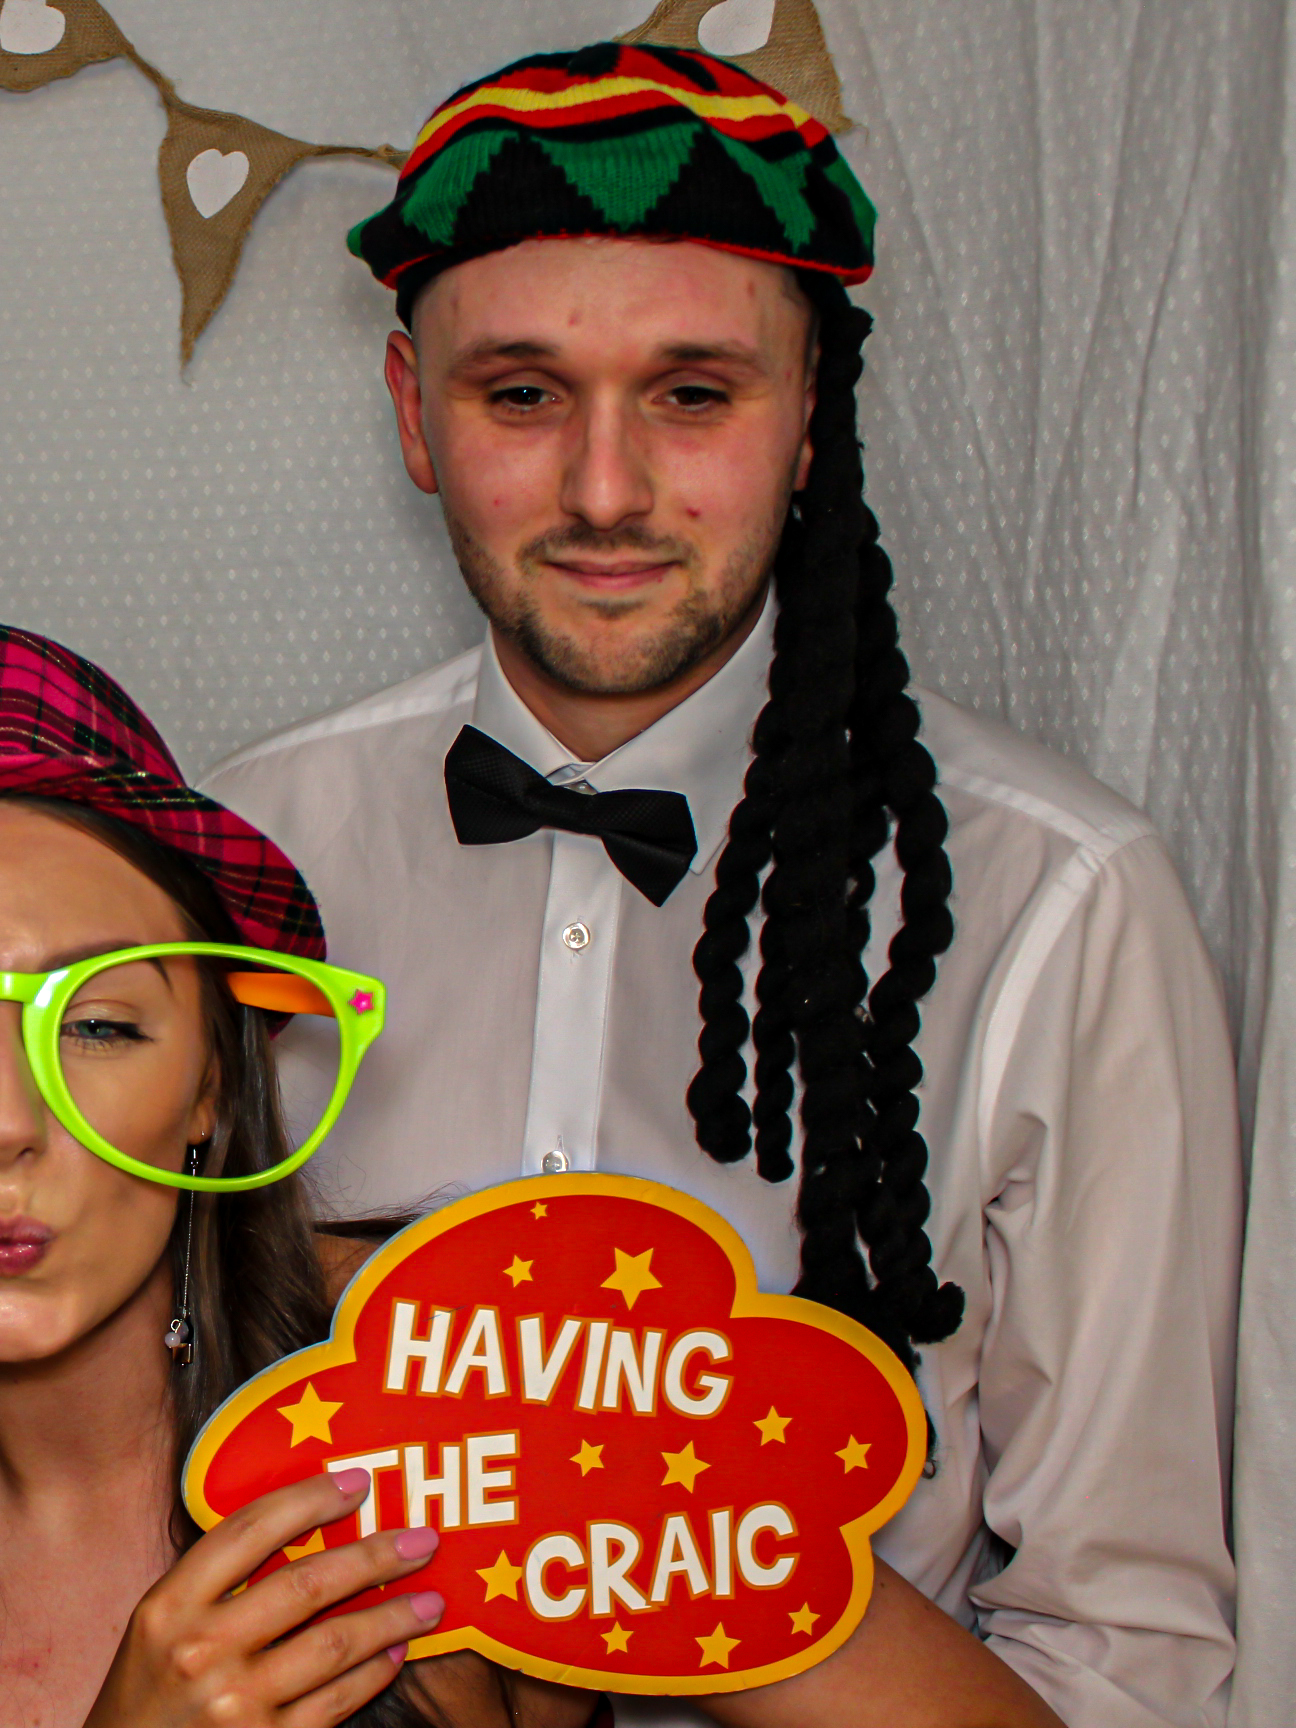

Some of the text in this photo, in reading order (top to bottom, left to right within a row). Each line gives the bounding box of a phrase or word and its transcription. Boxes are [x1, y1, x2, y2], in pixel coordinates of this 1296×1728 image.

[385, 1300, 734, 1418] HAVING
[326, 1431, 518, 1539] THE
[522, 1502, 800, 1620] CRAIC
